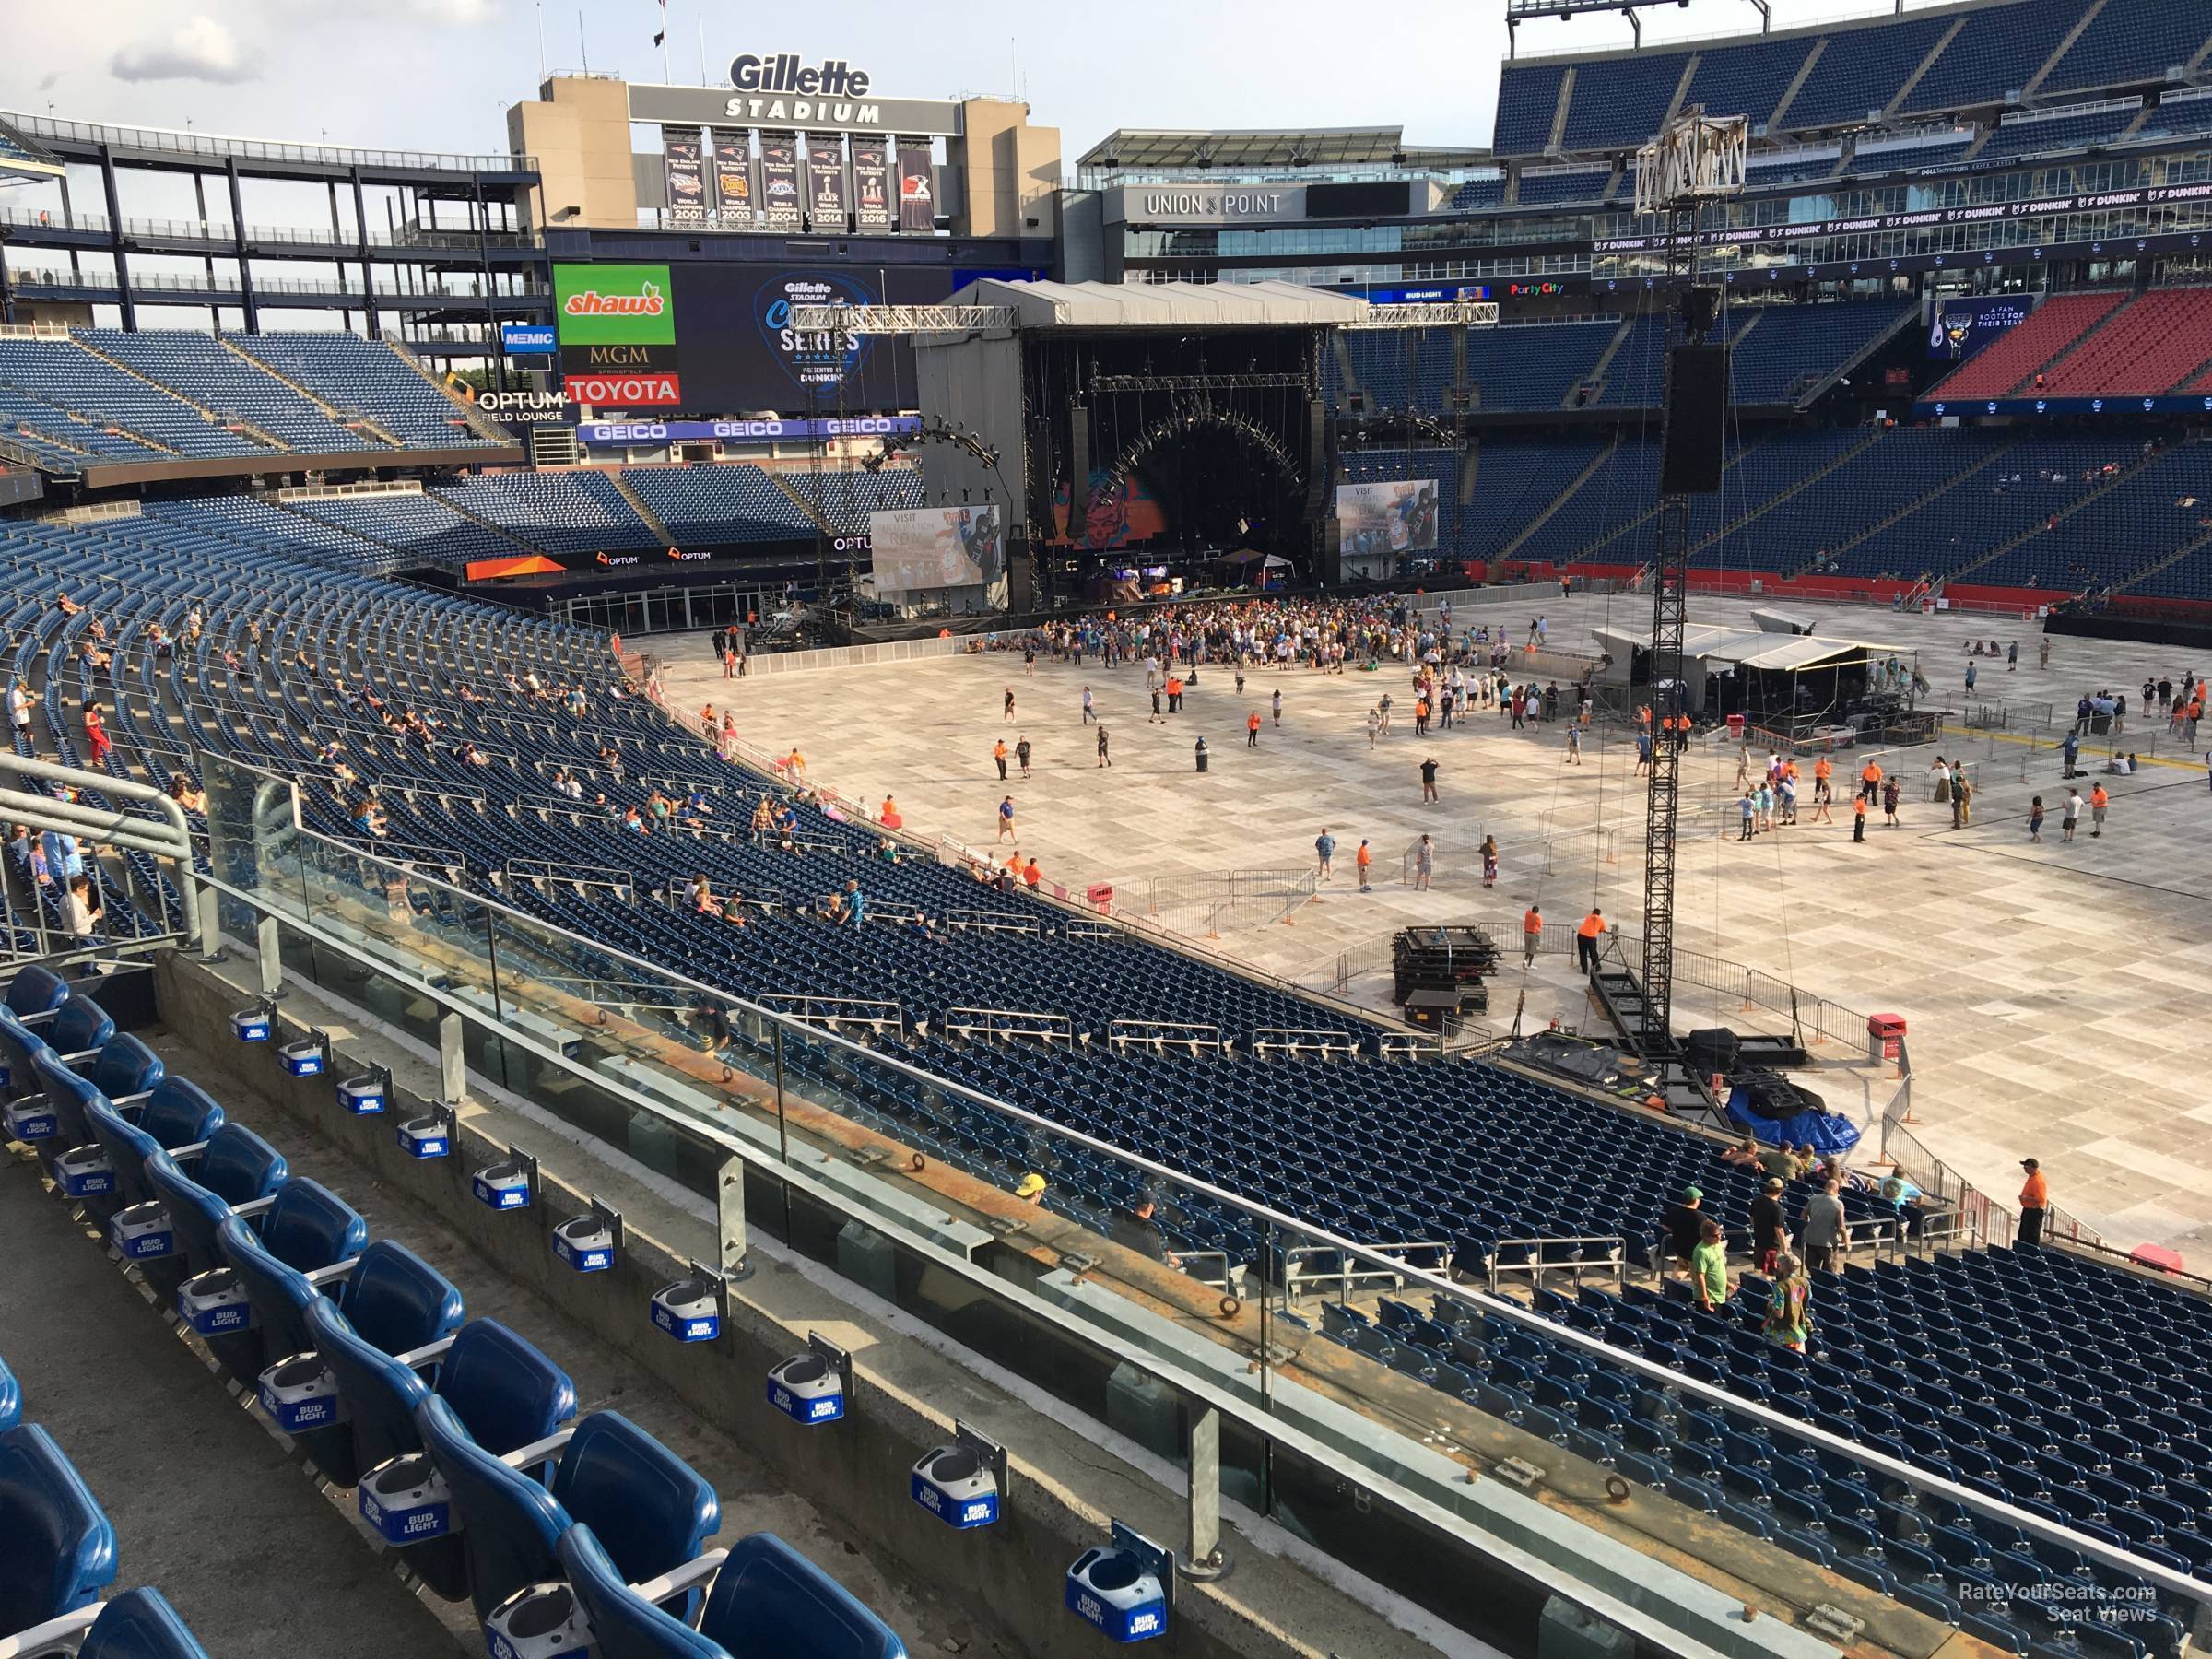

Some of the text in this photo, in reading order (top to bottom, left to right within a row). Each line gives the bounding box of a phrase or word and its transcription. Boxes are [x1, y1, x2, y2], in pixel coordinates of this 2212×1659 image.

[729, 53, 870, 98] Gillette
[725, 98, 879, 124] STADIUM
[1147, 194, 1280, 214] UNION POINT
[2096, 193, 2141, 206] DUNKIN'
[1965, 206, 2006, 218] DUNKIN'
[2030, 200, 2072, 212] DUNKIN'
[675, 210, 703, 219] 2001
[722, 210, 751, 220] 2003
[769, 213, 798, 221] 2004
[817, 214, 842, 223] 2014
[861, 215, 887, 223] 2016
[1903, 213, 1942, 224] DUNKIN'
[1843, 218, 1880, 230] DUNKIN'
[1725, 230, 1762, 241] DUNKIN'
[1784, 225, 1821, 236] DUNKIN'
[1609, 240, 1646, 250] DUNKIN'
[784, 282, 831, 293] Gillette
[506, 333, 553, 345] MEMIC
[590, 346, 649, 364] MGM
[569, 380, 677, 401] TOYOTA
[479, 391, 564, 411] OPTUM
[516, 411, 563, 422] LOUNGE
[714, 421, 782, 437] GEICO
[826, 418, 891, 434] GEICO
[594, 424, 667, 441] GEICO
[1355, 487, 1372, 496] VISIT
[893, 513, 917, 523] VISIT
[890, 532, 922, 545] ROW
[608, 557, 638, 566] OPTUM
[681, 552, 711, 560] OPTUM
[82, 1182, 108, 1191] LIGHT
[137, 1242, 164, 1253] LIGHT
[141, 1238, 160, 1246] BUD
[211, 1316, 241, 1326] LIGHT
[216, 1311, 237, 1319] BUD
[658, 1309, 670, 1322] BUD
[655, 1314, 672, 1331] LIGHT
[691, 1322, 709, 1330] BUD
[688, 1328, 712, 1336] LIGHT
[776, 1389, 790, 1404] BUD
[774, 1394, 793, 1412] LIGHT
[815, 1401, 833, 1411] BUD
[299, 1404, 323, 1415] BUD
[811, 1406, 836, 1418] LIGHT
[294, 1410, 327, 1422] LIGHT
[923, 1485, 938, 1503] BUD
[367, 1496, 379, 1514] BUD
[919, 1493, 942, 1512] LIGHT
[967, 1503, 988, 1514] BUD
[365, 1504, 382, 1526] LIGHT
[408, 1512, 434, 1524] BUD
[963, 1510, 991, 1522] LIGHT
[404, 1520, 440, 1534] LIGHT
[1081, 1594, 1101, 1612] BUD
[1077, 1600, 1104, 1625] LIGHT
[1135, 1613, 1155, 1625] BUD
[1130, 1620, 1159, 1635] LIGHT
